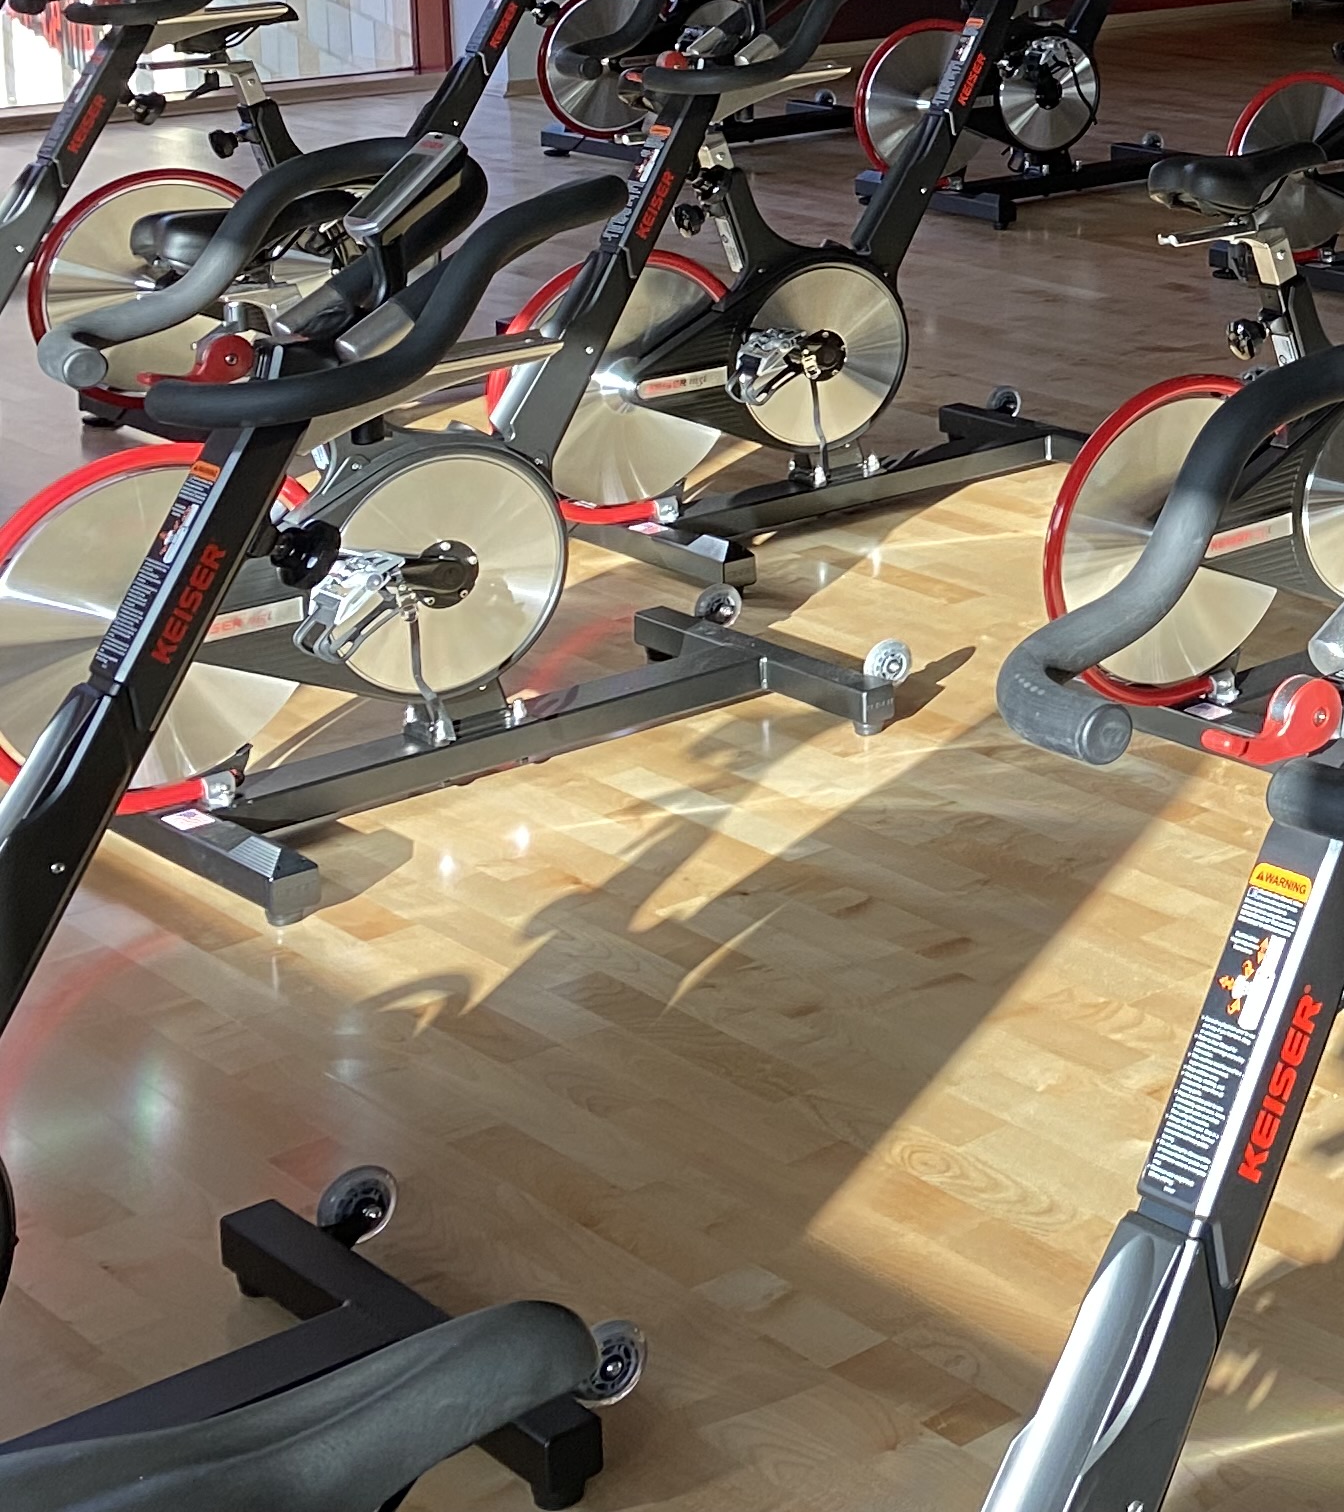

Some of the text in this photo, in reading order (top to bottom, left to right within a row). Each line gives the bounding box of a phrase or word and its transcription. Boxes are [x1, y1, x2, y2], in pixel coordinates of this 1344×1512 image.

[958, 52, 986, 106] KEISER
[635, 170, 674, 240] KEISER
[151, 544, 226, 664] KEISER
[1265, 873, 1307, 895] WARNING
[1238, 993, 1323, 1184] KEISER
